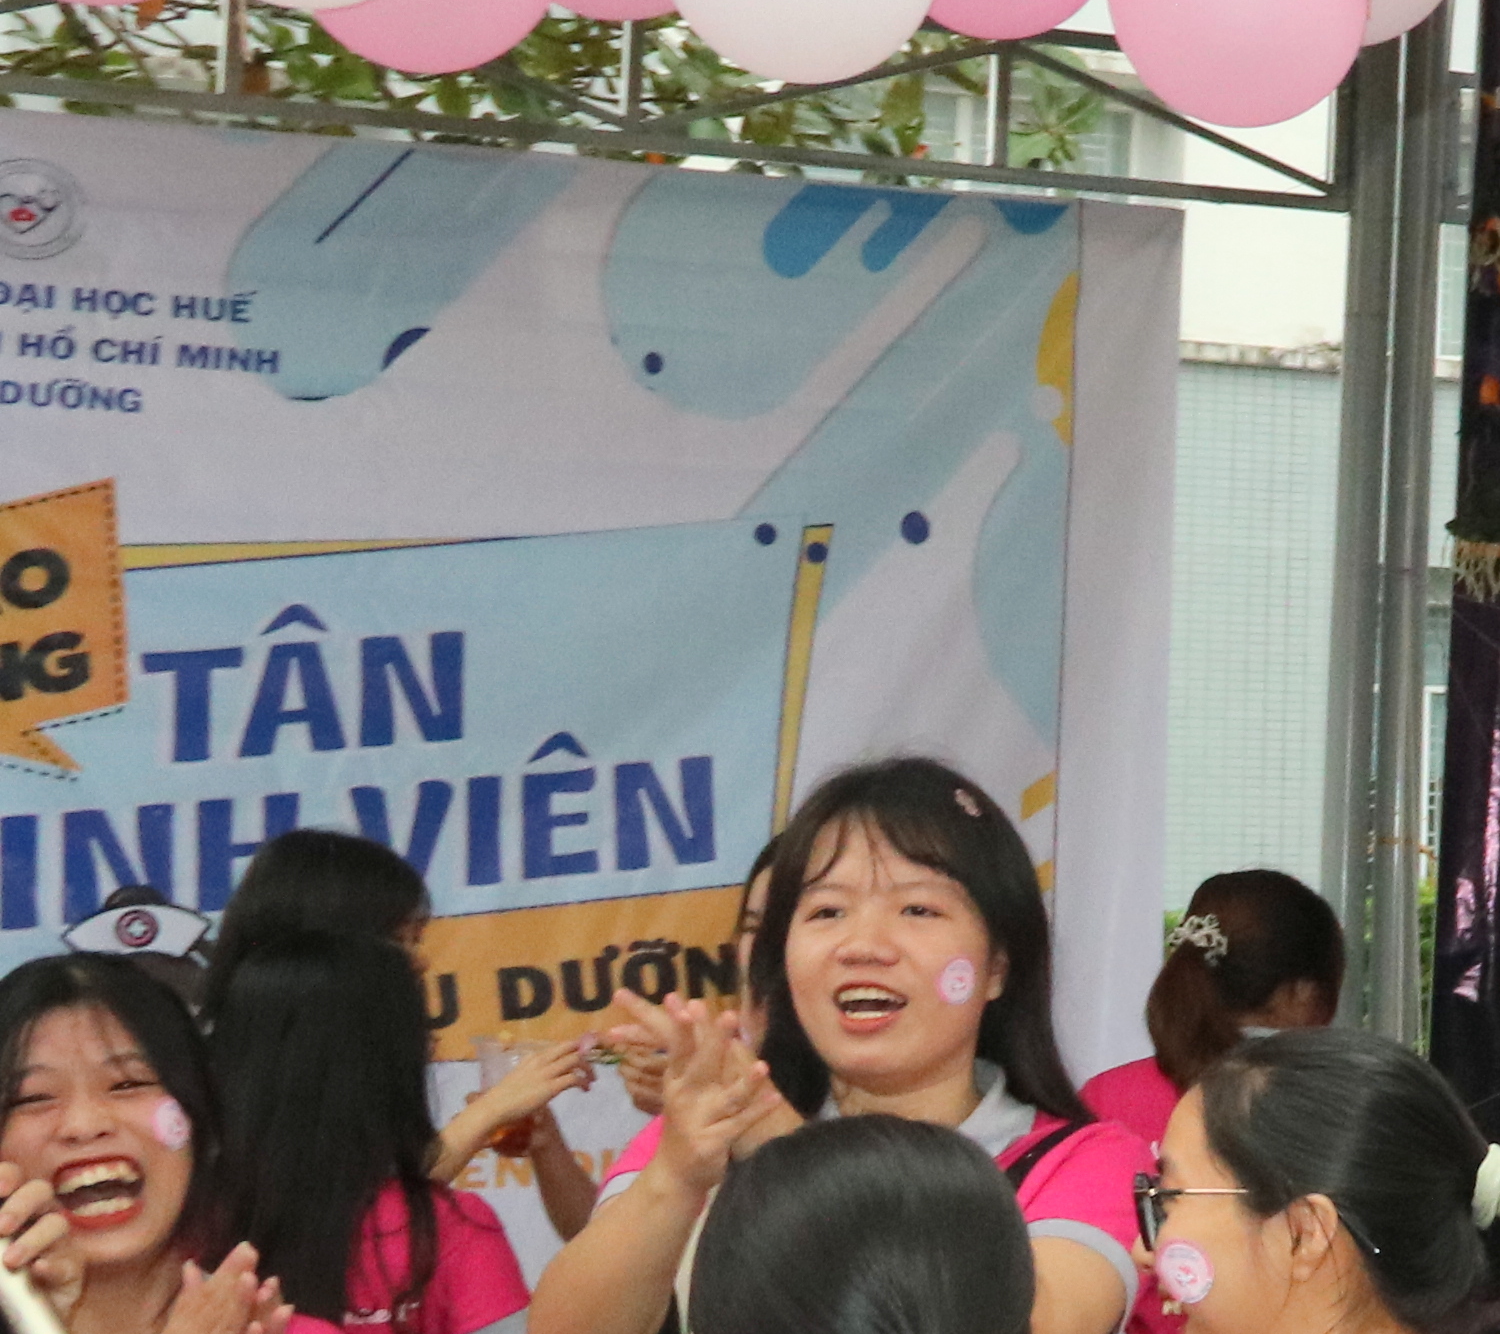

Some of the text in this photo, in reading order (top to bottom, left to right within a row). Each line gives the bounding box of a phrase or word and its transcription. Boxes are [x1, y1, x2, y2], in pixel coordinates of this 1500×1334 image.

[72, 287, 155, 320] HỌC
[171, 290, 258, 323] HUẾ
[175, 343, 280, 374] MINH
[142, 602, 467, 764] TÂN
[349, 729, 717, 911] VIÊN
[500, 938, 742, 1023] DƯỠN
